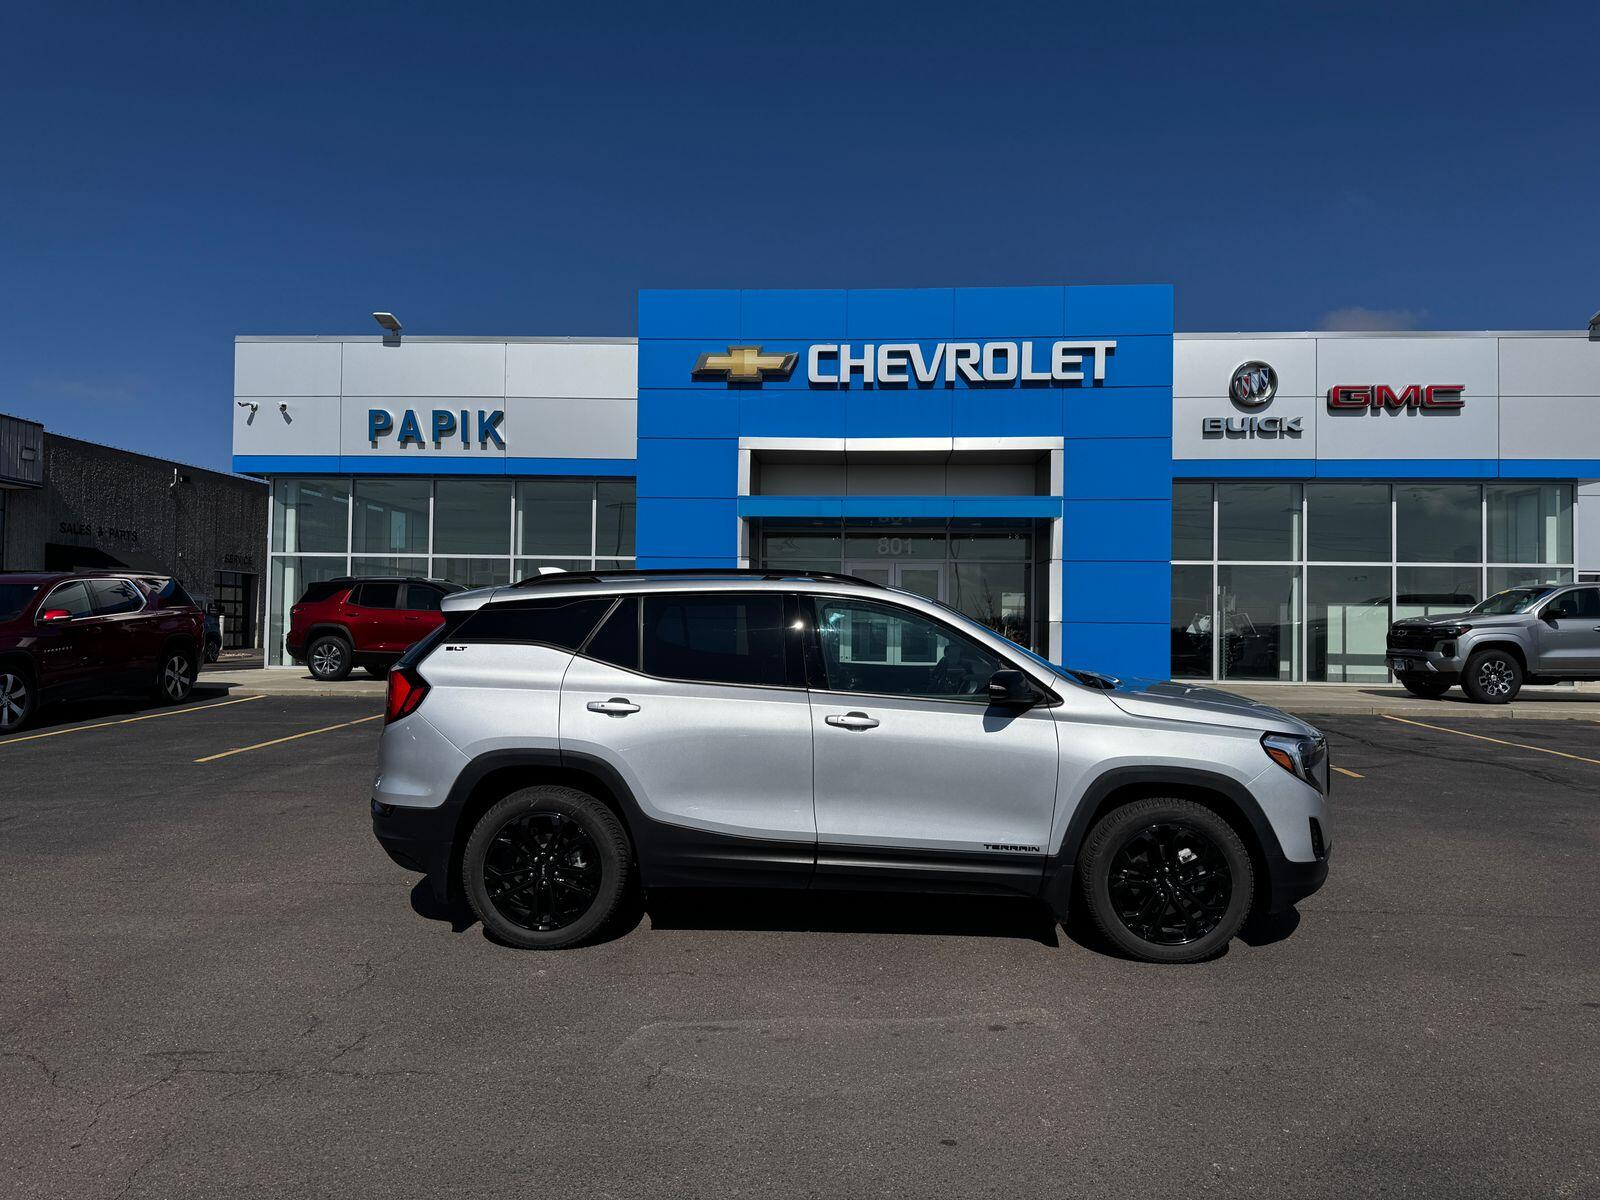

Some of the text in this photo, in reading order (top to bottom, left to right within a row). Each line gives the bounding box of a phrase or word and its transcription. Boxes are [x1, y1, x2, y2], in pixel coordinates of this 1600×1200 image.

[807, 340, 1118, 384] CHEVROLET
[1328, 384, 1466, 410] GMC
[368, 408, 506, 446] PAPIK
[1202, 416, 1304, 435] BUICK
[59, 521, 92, 536] SALES
[109, 529, 138, 541] PARTS
[878, 537, 912, 555] 801
[983, 843, 1040, 852] TERRAIN
